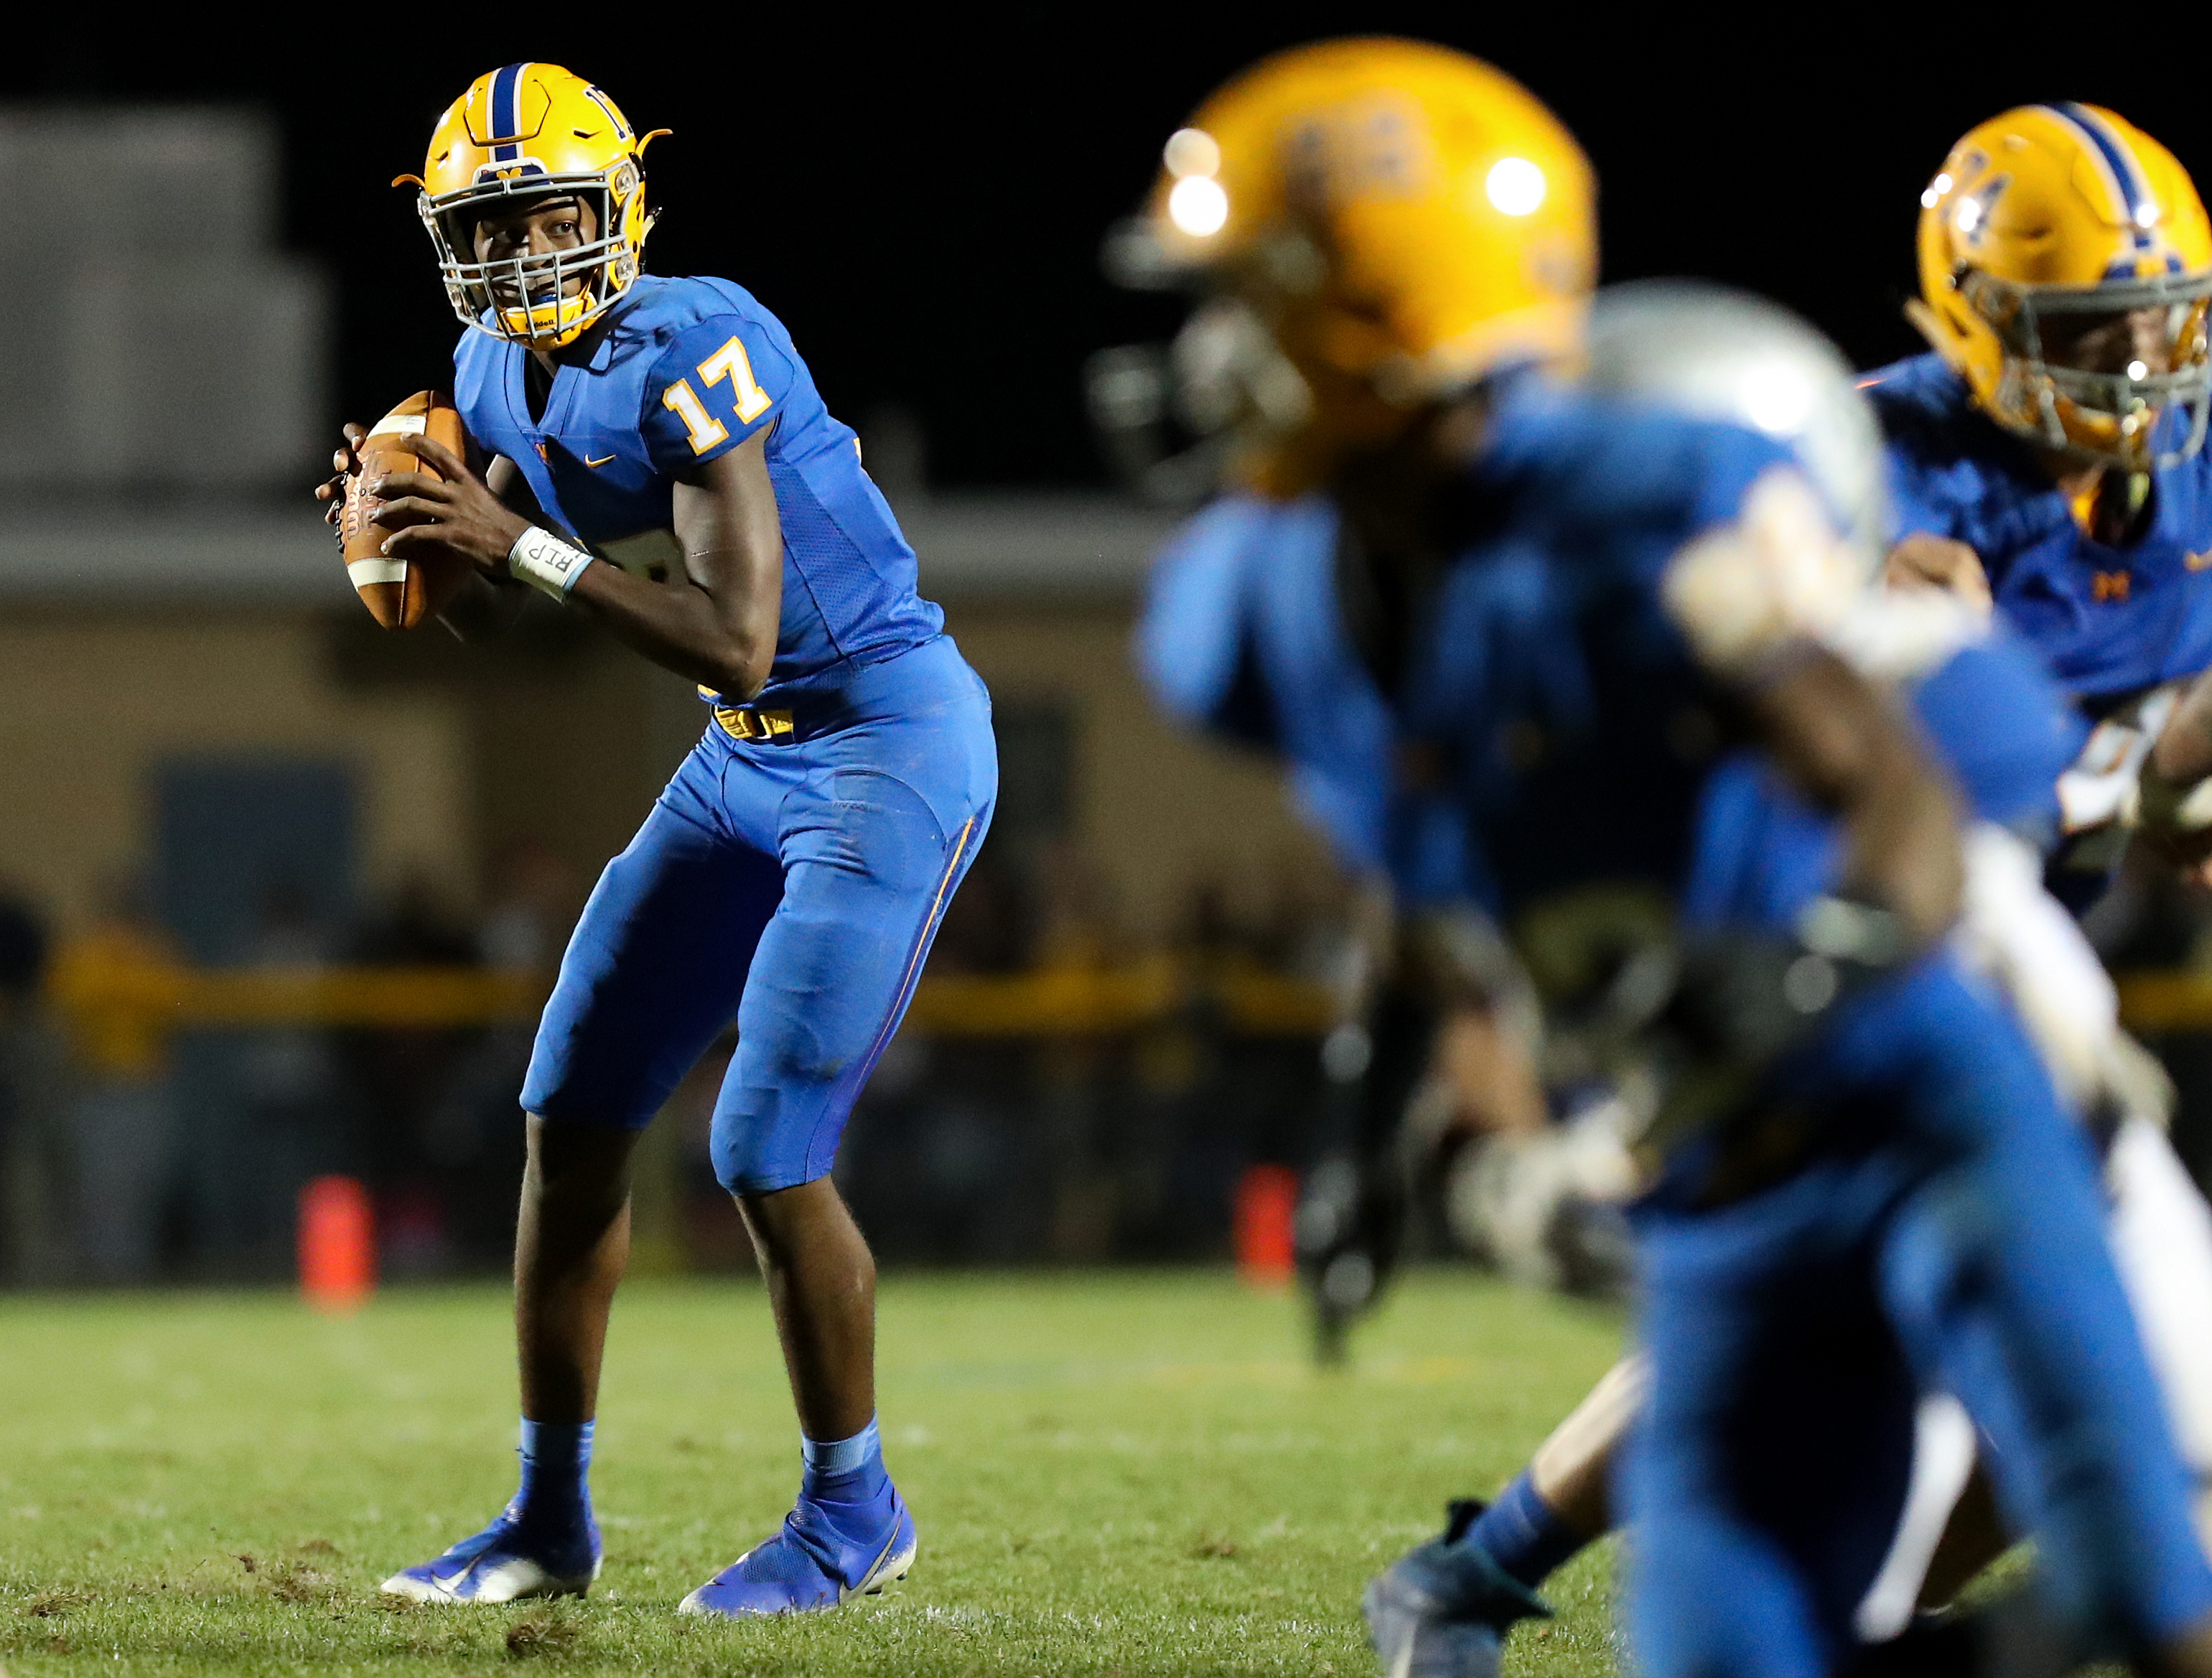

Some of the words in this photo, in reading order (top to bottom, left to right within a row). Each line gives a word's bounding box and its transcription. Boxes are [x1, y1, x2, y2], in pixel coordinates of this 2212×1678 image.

[662, 335, 773, 456] 17
[347, 453, 369, 540] Wils
[528, 544, 573, 573] RIP
